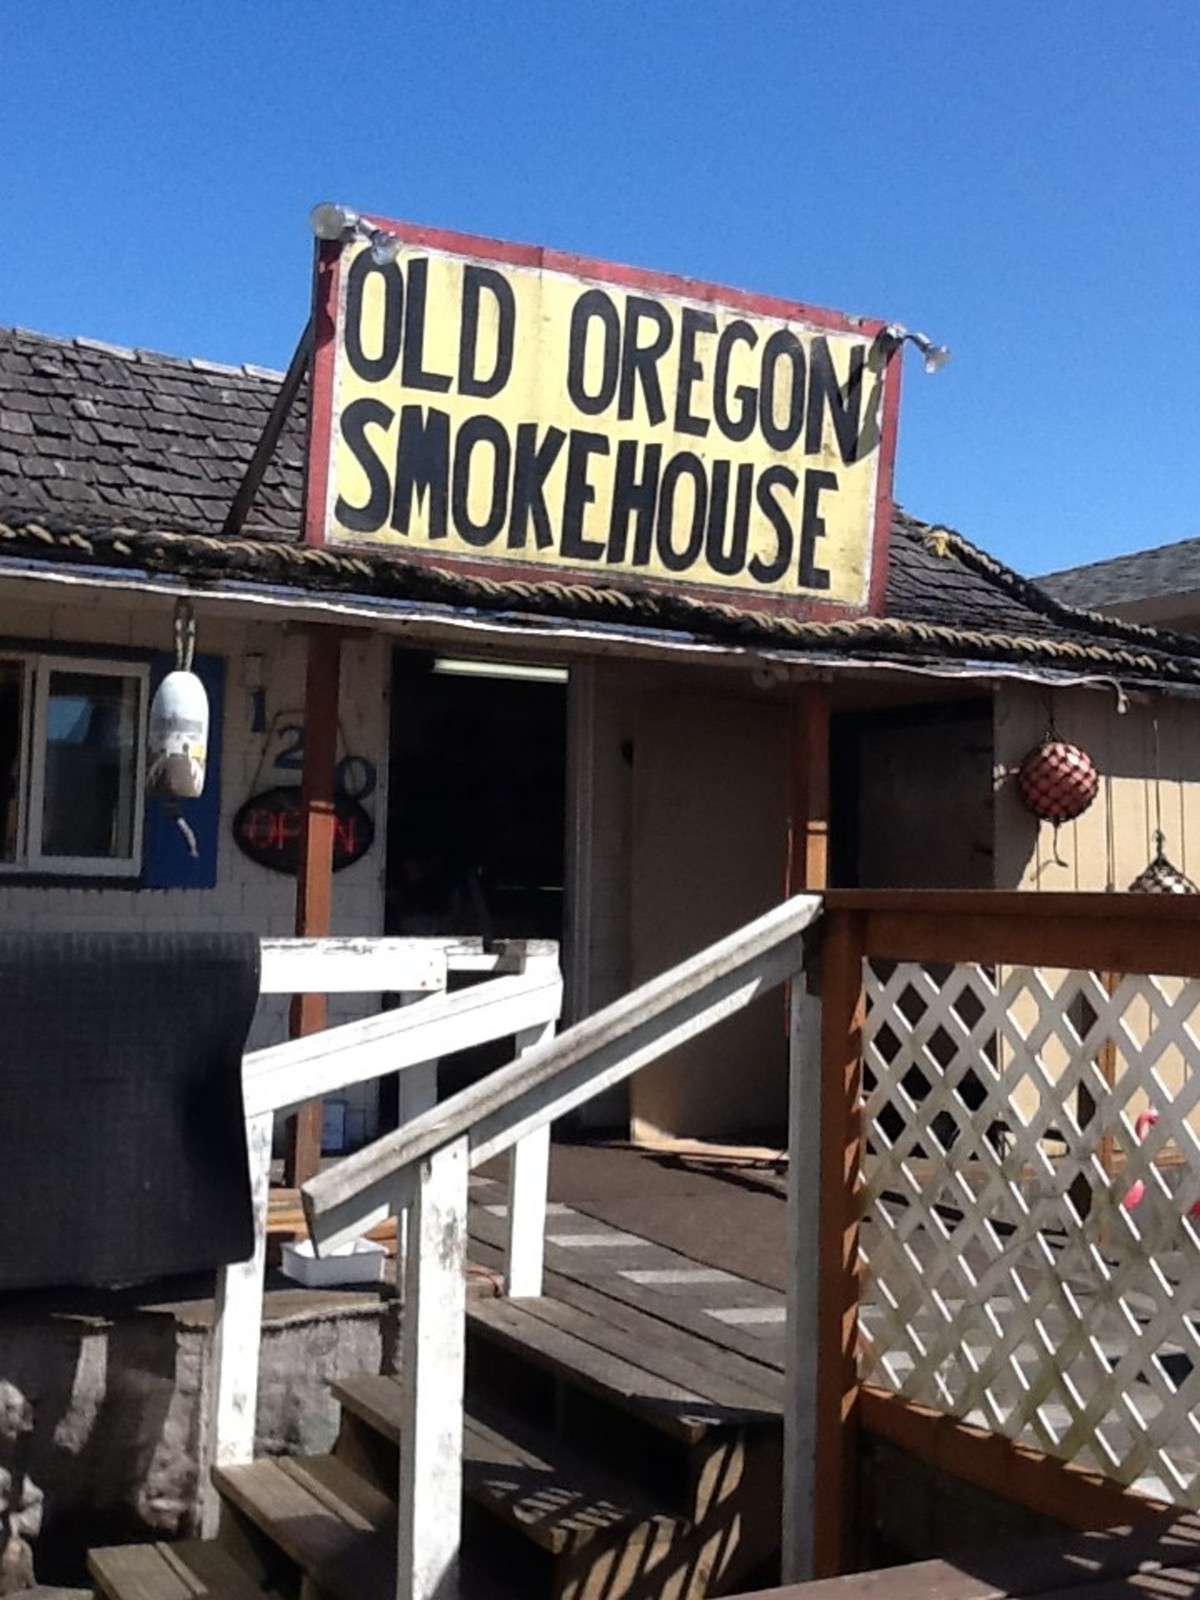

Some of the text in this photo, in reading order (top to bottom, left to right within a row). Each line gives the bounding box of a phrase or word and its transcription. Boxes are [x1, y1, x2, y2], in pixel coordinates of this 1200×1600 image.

[344, 246, 866, 465] OLD OREGON
[335, 398, 838, 589] SMOKEHOUSE
[246, 808, 358, 854] OPN
